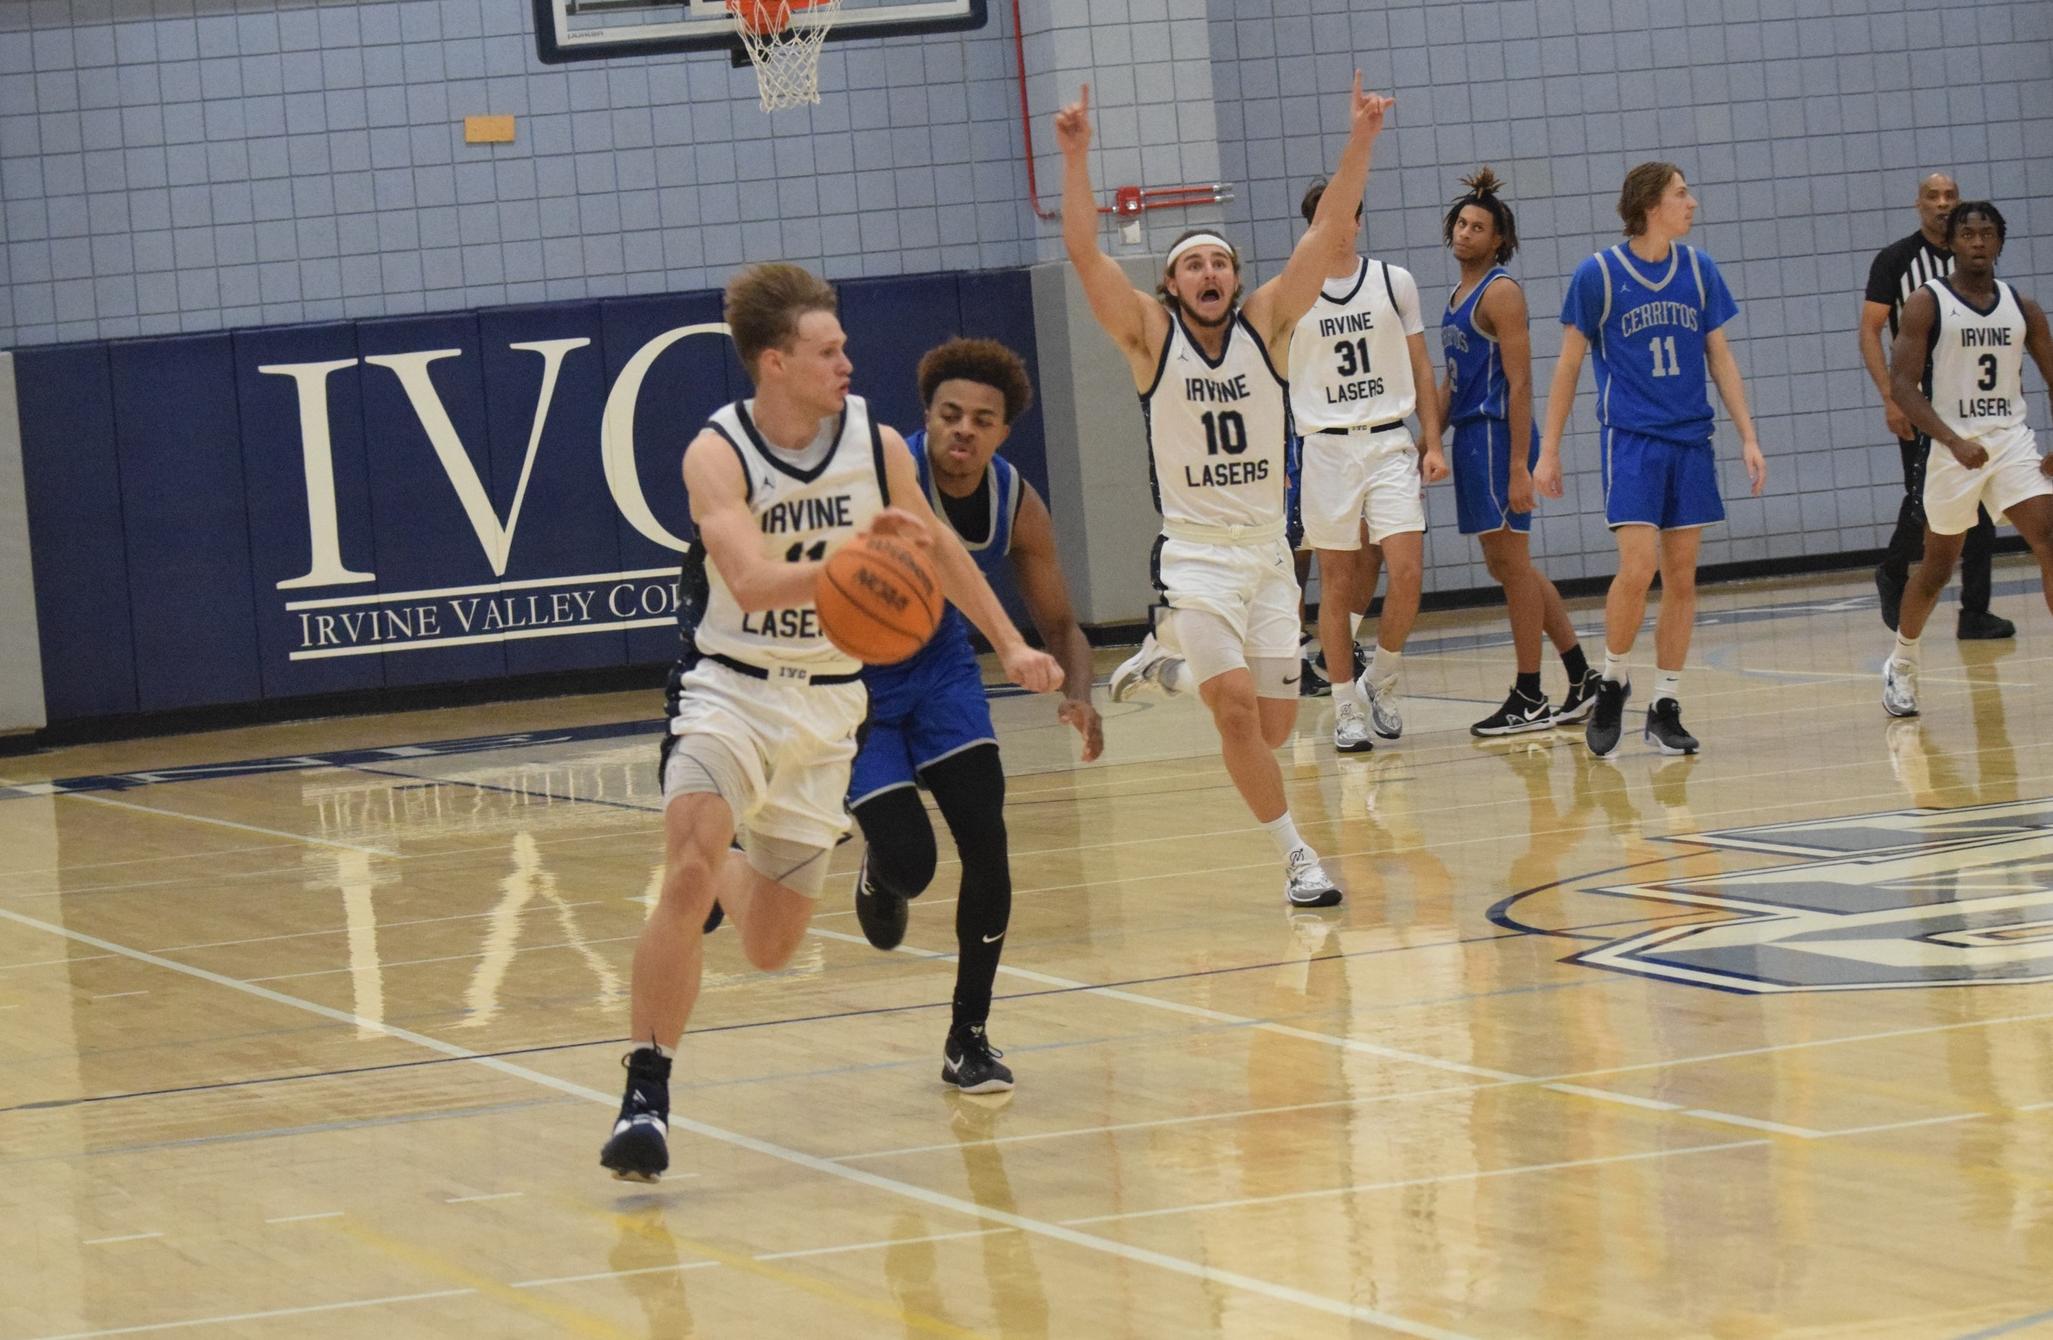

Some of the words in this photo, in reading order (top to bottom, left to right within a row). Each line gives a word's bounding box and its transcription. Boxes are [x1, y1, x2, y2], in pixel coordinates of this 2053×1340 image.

[1320, 312, 1374, 338] IRVINE
[1621, 301, 1698, 338] CERRITOS
[1961, 327, 2012, 347] IRVINE
[1334, 337, 1371, 378] 31
[1649, 336, 1680, 377] 11
[1977, 353, 1998, 391] 3
[1185, 374, 1251, 403] IRVINE
[1326, 377, 1385, 404] LASERS
[1201, 410, 1248, 455] 10
[258, 322, 732, 590] IVC
[1185, 459, 1270, 488] LASERS
[761, 495, 853, 534] IRVINE
[300, 606, 441, 648] IRVINE
[449, 591, 596, 633] VALLEY
[742, 608, 824, 639] LASE
